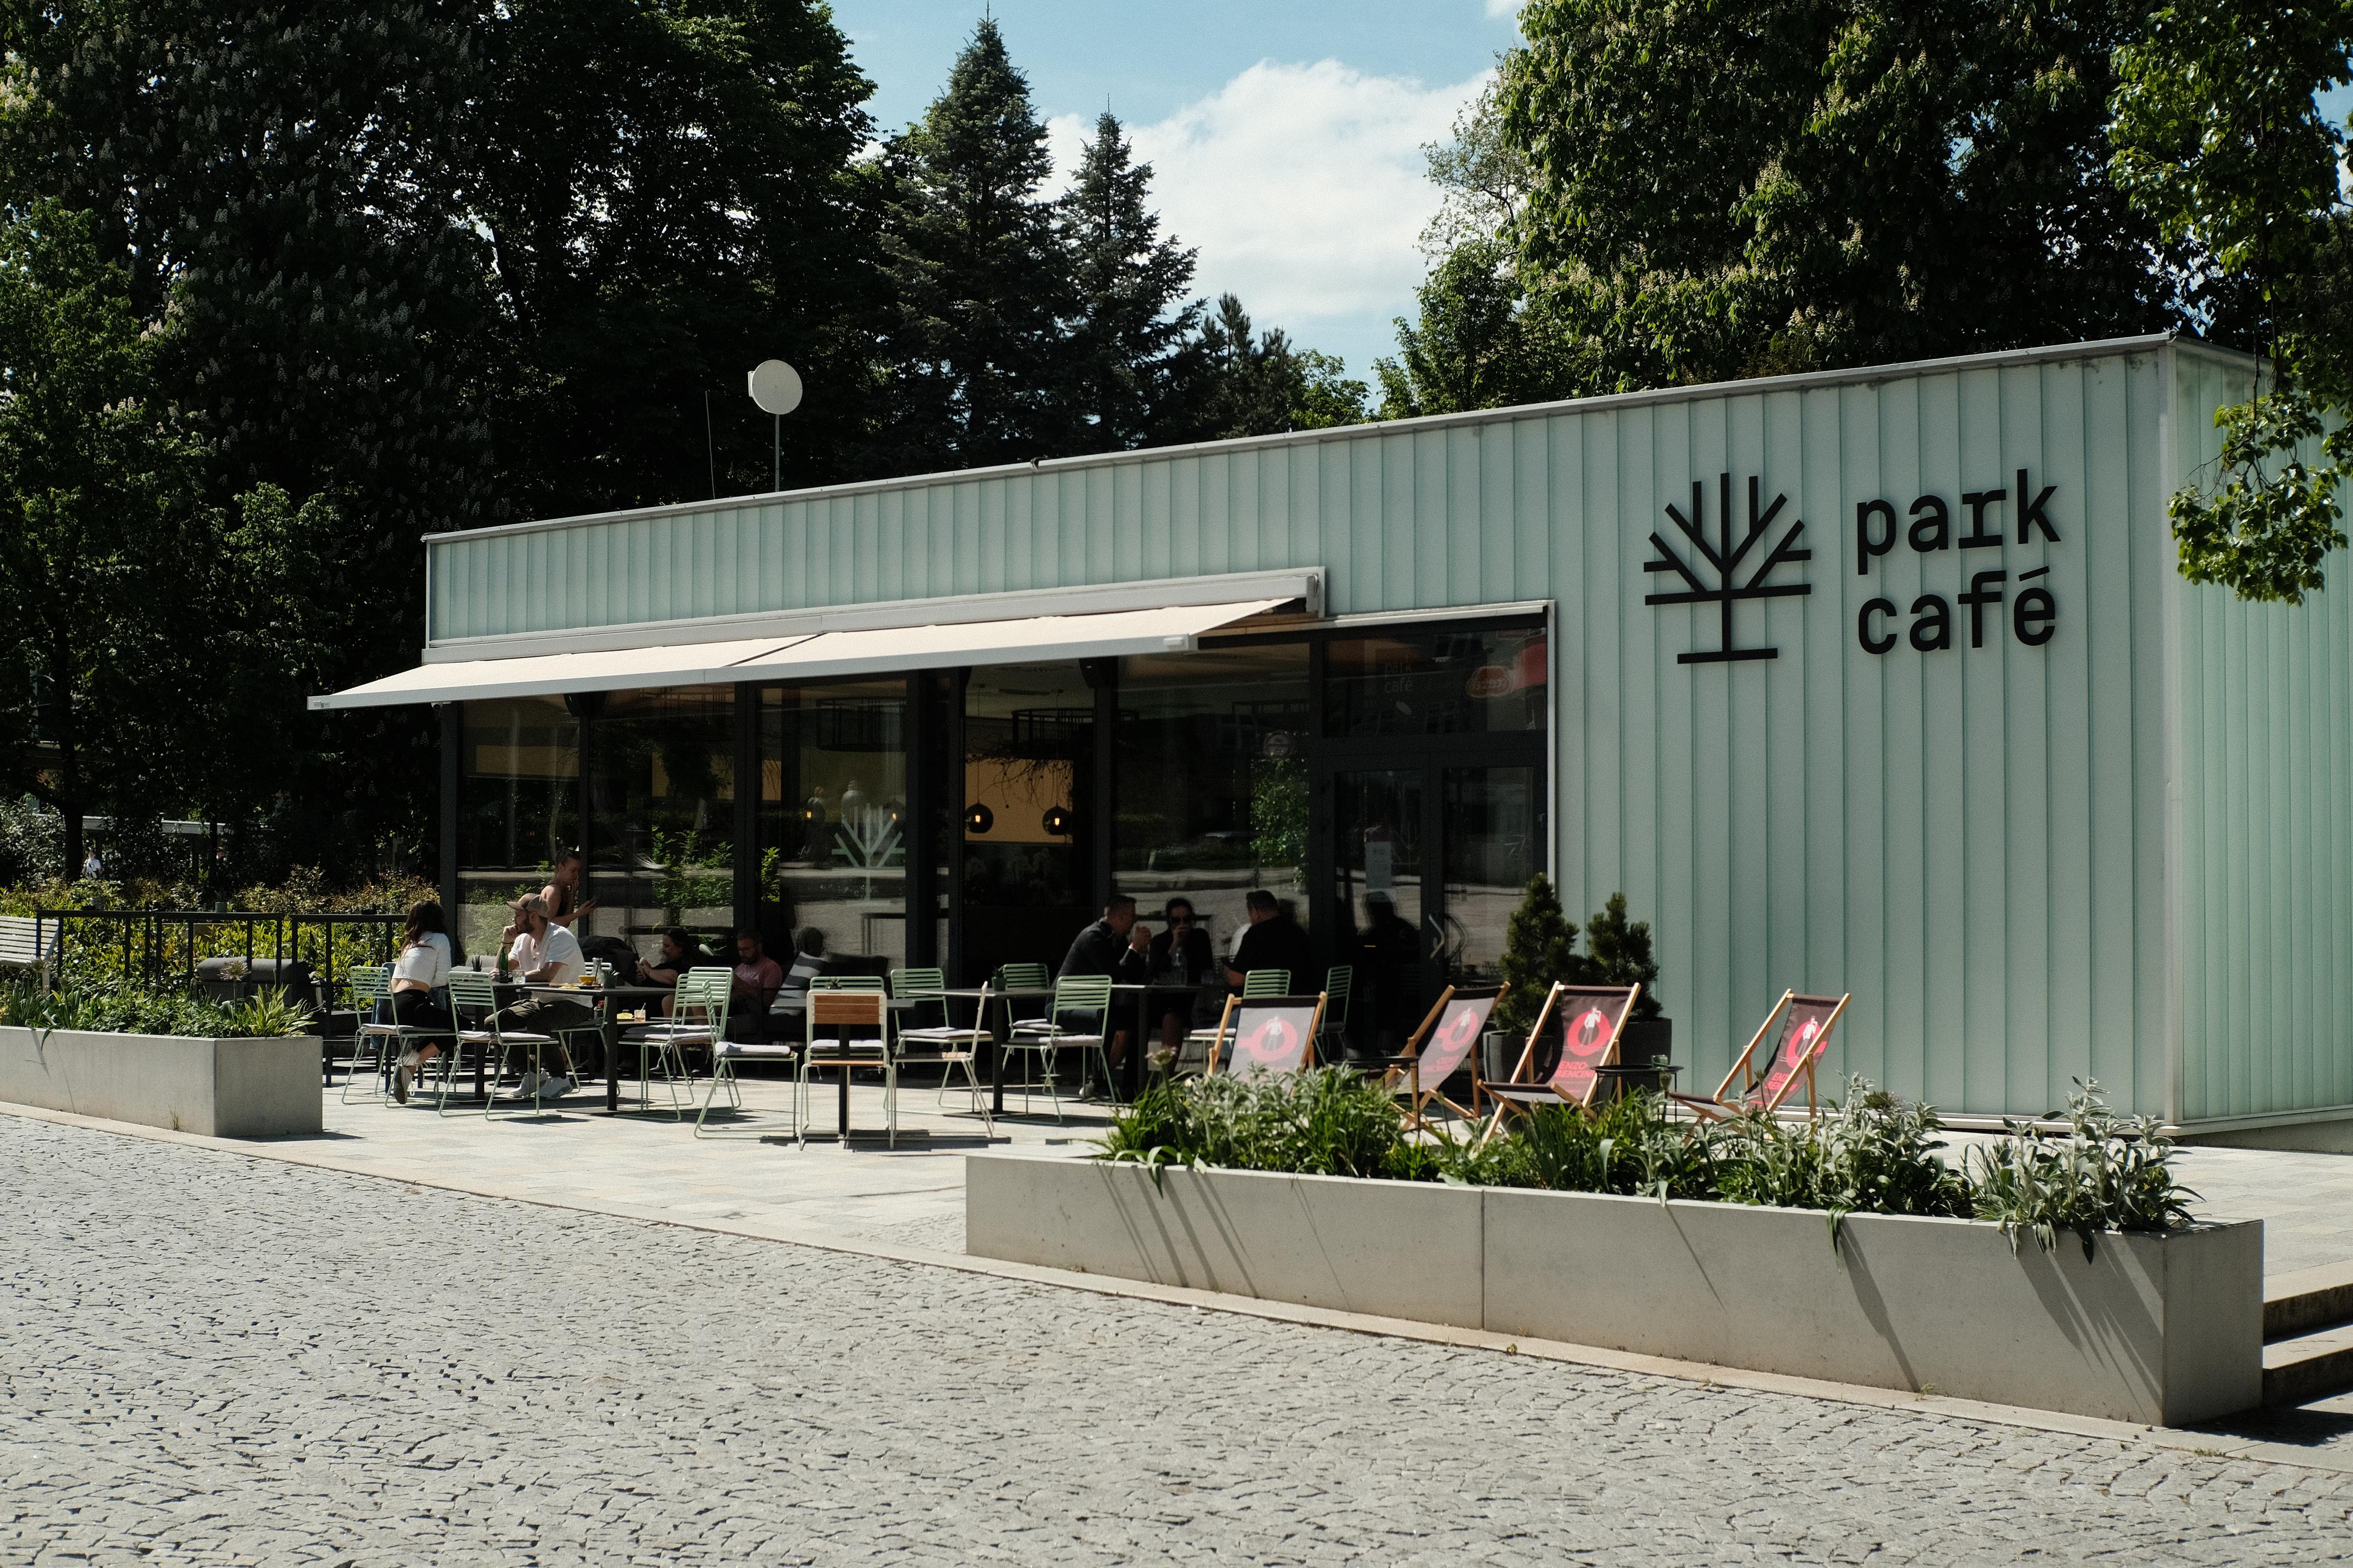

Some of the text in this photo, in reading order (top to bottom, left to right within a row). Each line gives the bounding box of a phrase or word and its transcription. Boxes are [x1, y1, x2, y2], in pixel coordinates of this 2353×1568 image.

[1857, 469, 2061, 575] park
[1858, 566, 2056, 655] café
[1384, 676, 1413, 693] café
[1557, 1060, 1589, 1070] ENZO
